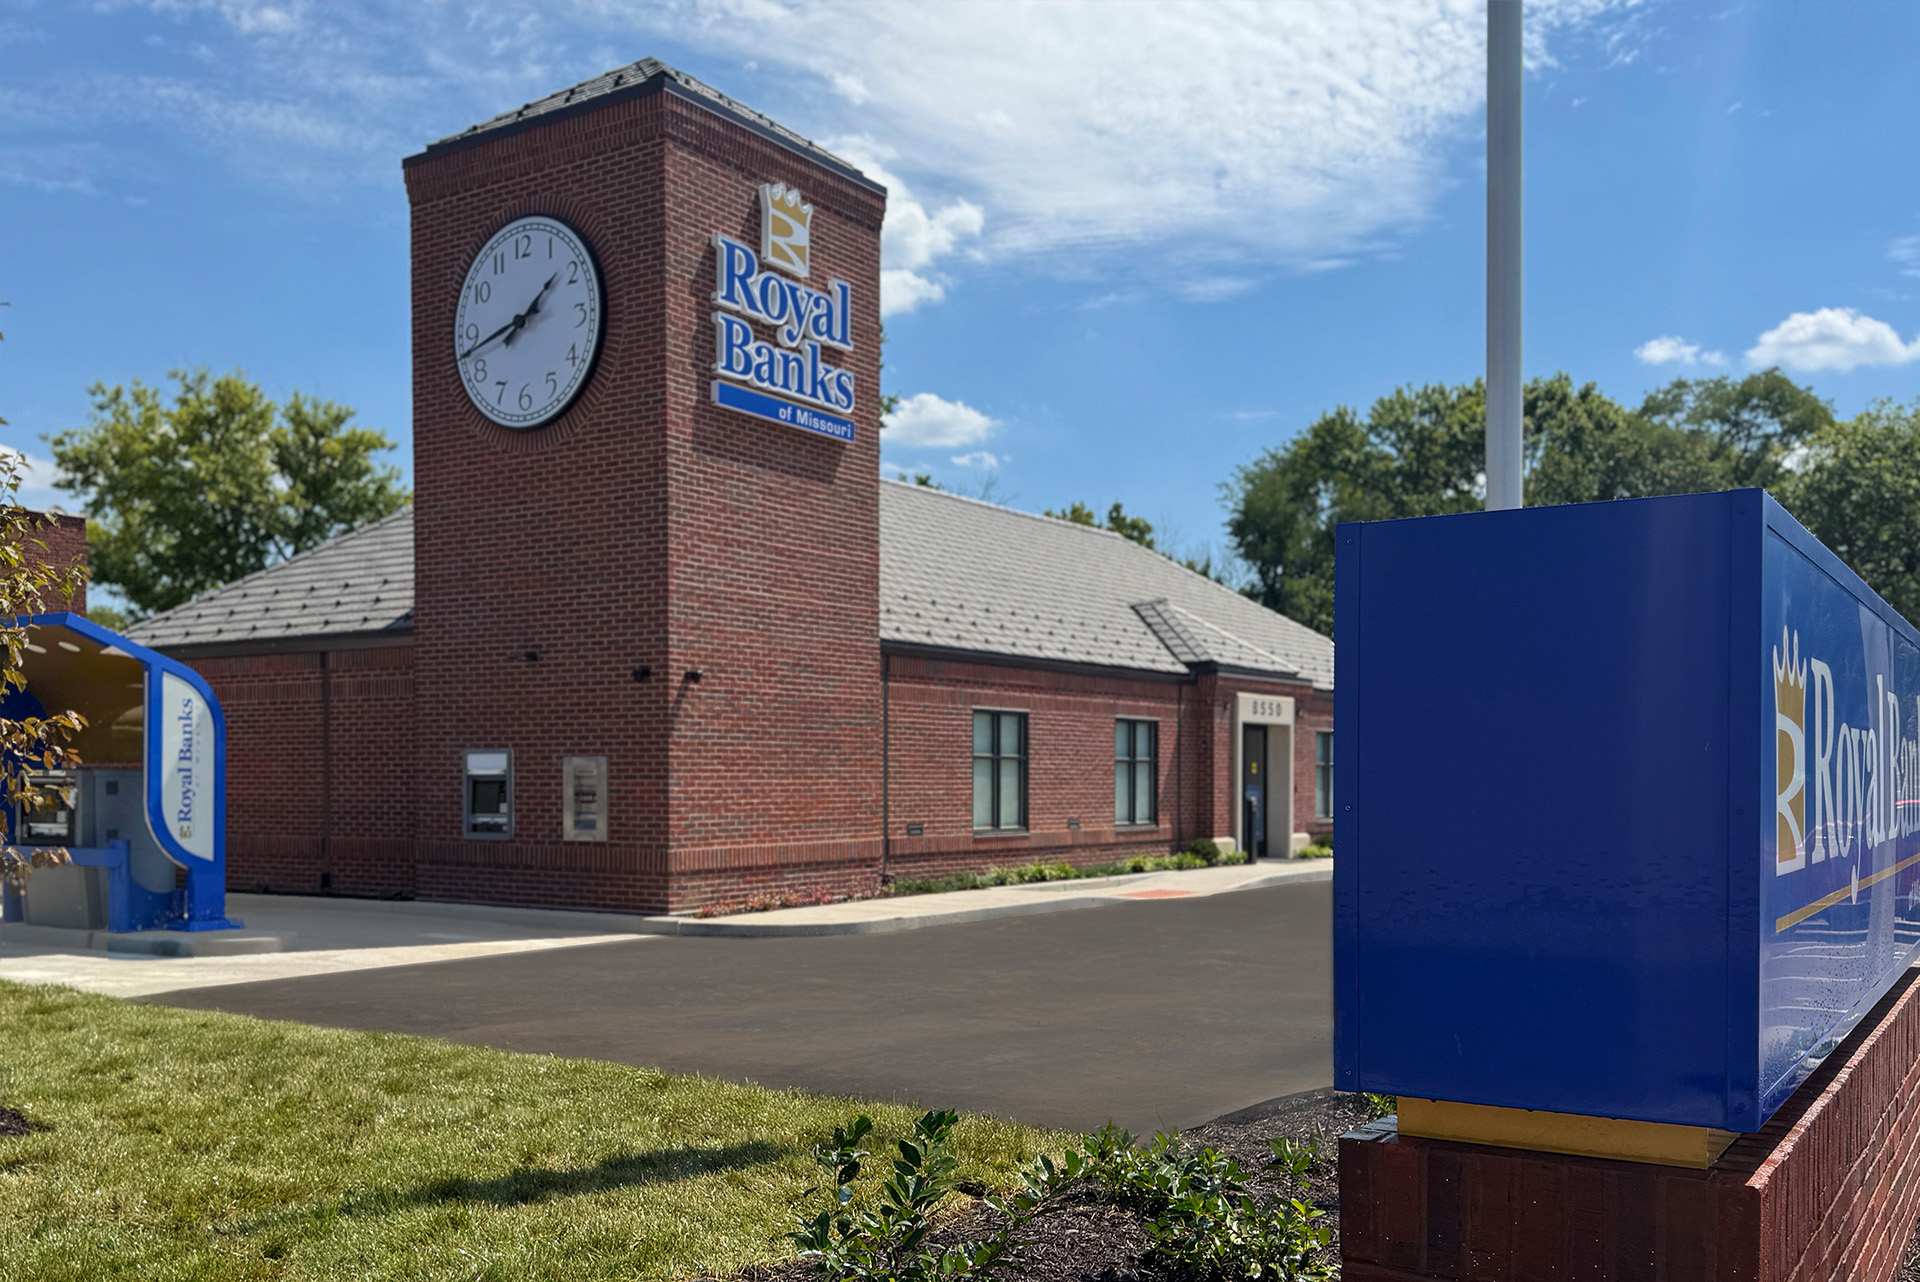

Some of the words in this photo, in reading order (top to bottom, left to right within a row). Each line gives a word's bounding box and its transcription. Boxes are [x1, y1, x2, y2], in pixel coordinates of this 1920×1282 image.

[515, 234, 532, 260] 12
[548, 236, 553, 259] 1
[493, 252, 505, 275] 11
[566, 260, 579, 285] 2
[474, 281, 491, 304] 10
[718, 236, 852, 349] Royal
[574, 303, 587, 329] 3
[466, 323, 479, 351] 9
[565, 342, 580, 367] 4
[718, 313, 854, 413] Banks
[473, 358, 487, 383] 8
[495, 380, 508, 405] 7
[518, 382, 533, 411] 6
[545, 371, 557, 399] 5
[778, 406, 792, 420] of
[796, 408, 851, 438] Missouri
[1252, 701, 1282, 716] 8550
[178, 698, 193, 762] Banks
[1811, 657, 1886, 905] Royal
[178, 768, 196, 823] Royal
